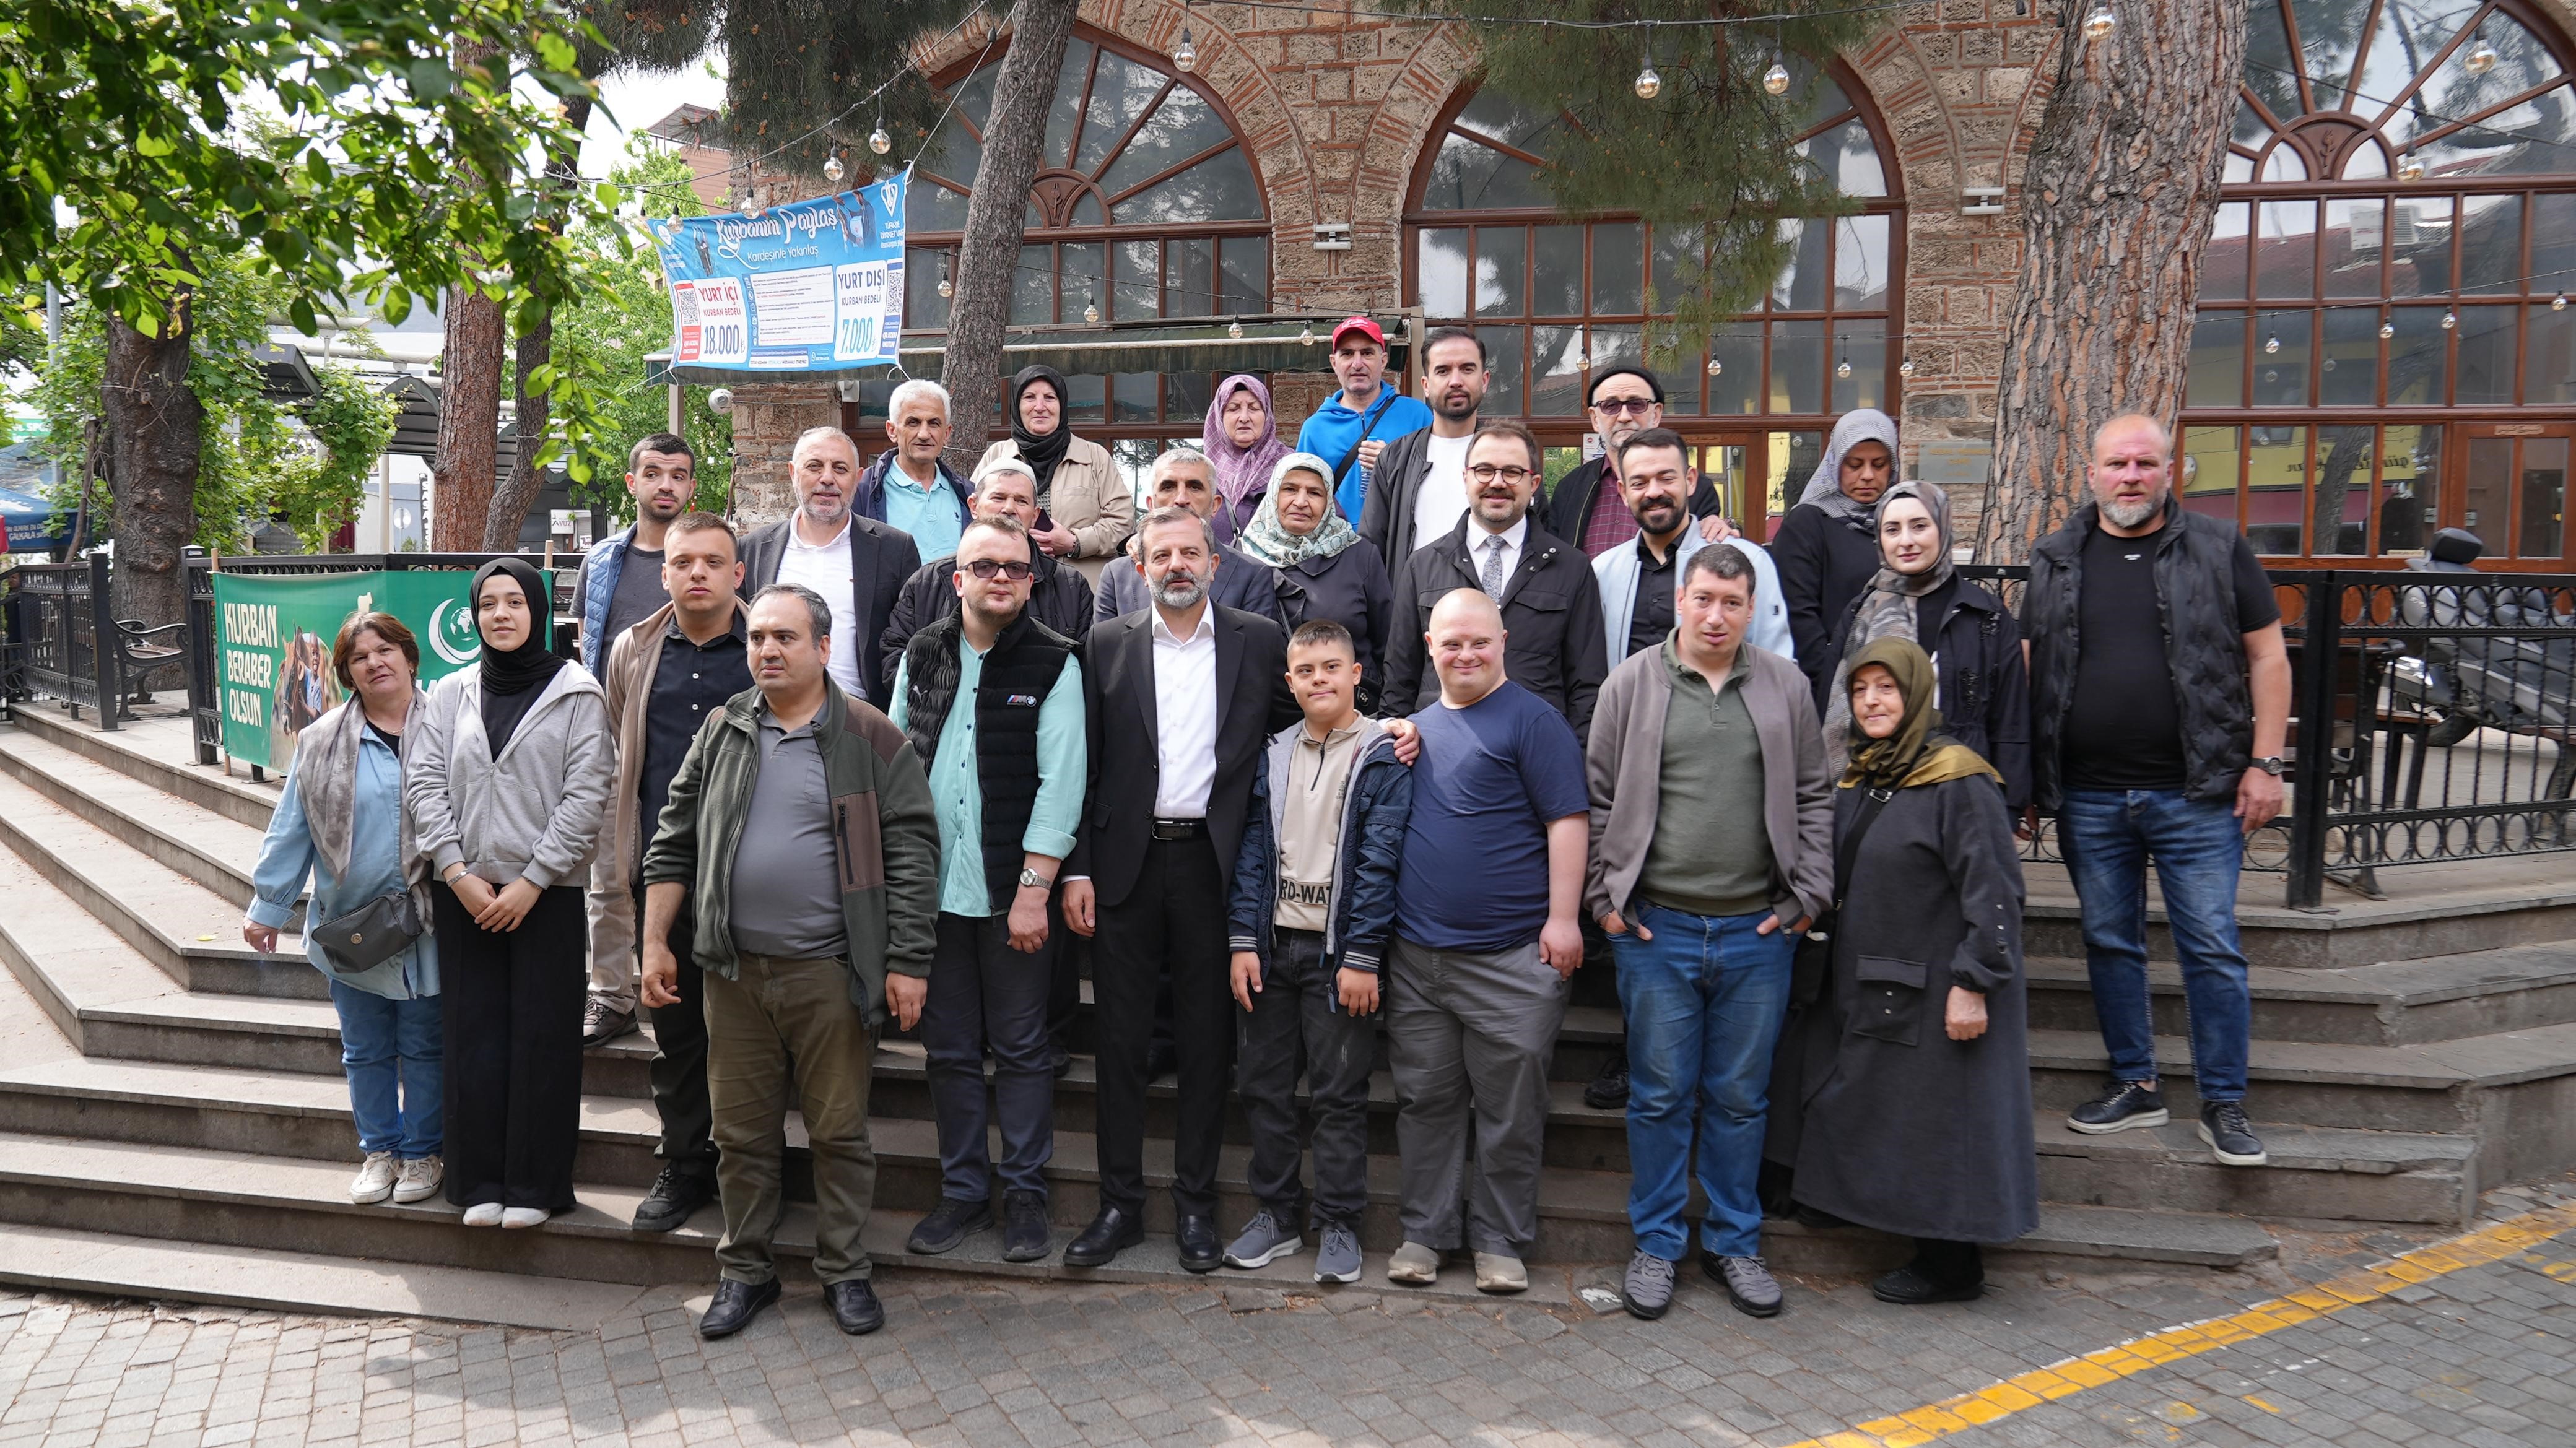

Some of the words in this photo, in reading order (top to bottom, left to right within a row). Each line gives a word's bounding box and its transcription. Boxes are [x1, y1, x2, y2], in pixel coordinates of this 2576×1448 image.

[777, 206, 837, 244] Paylaş
[747, 248, 786, 263] Kardeşinle
[787, 244, 819, 257] Yakınlaş
[838, 271, 863, 290] YURT
[867, 269, 886, 292] DIŞI
[698, 287, 723, 302] YURT
[723, 281, 739, 305] İÇİ
[842, 295, 863, 306] KURBAN
[864, 293, 881, 305] BEDELİ
[703, 308, 723, 317] KURBAN
[724, 306, 741, 316] BEDELİ
[224, 602, 278, 649] KURBAN
[226, 649, 272, 689] BERABER
[228, 688, 262, 728] OLSUN
